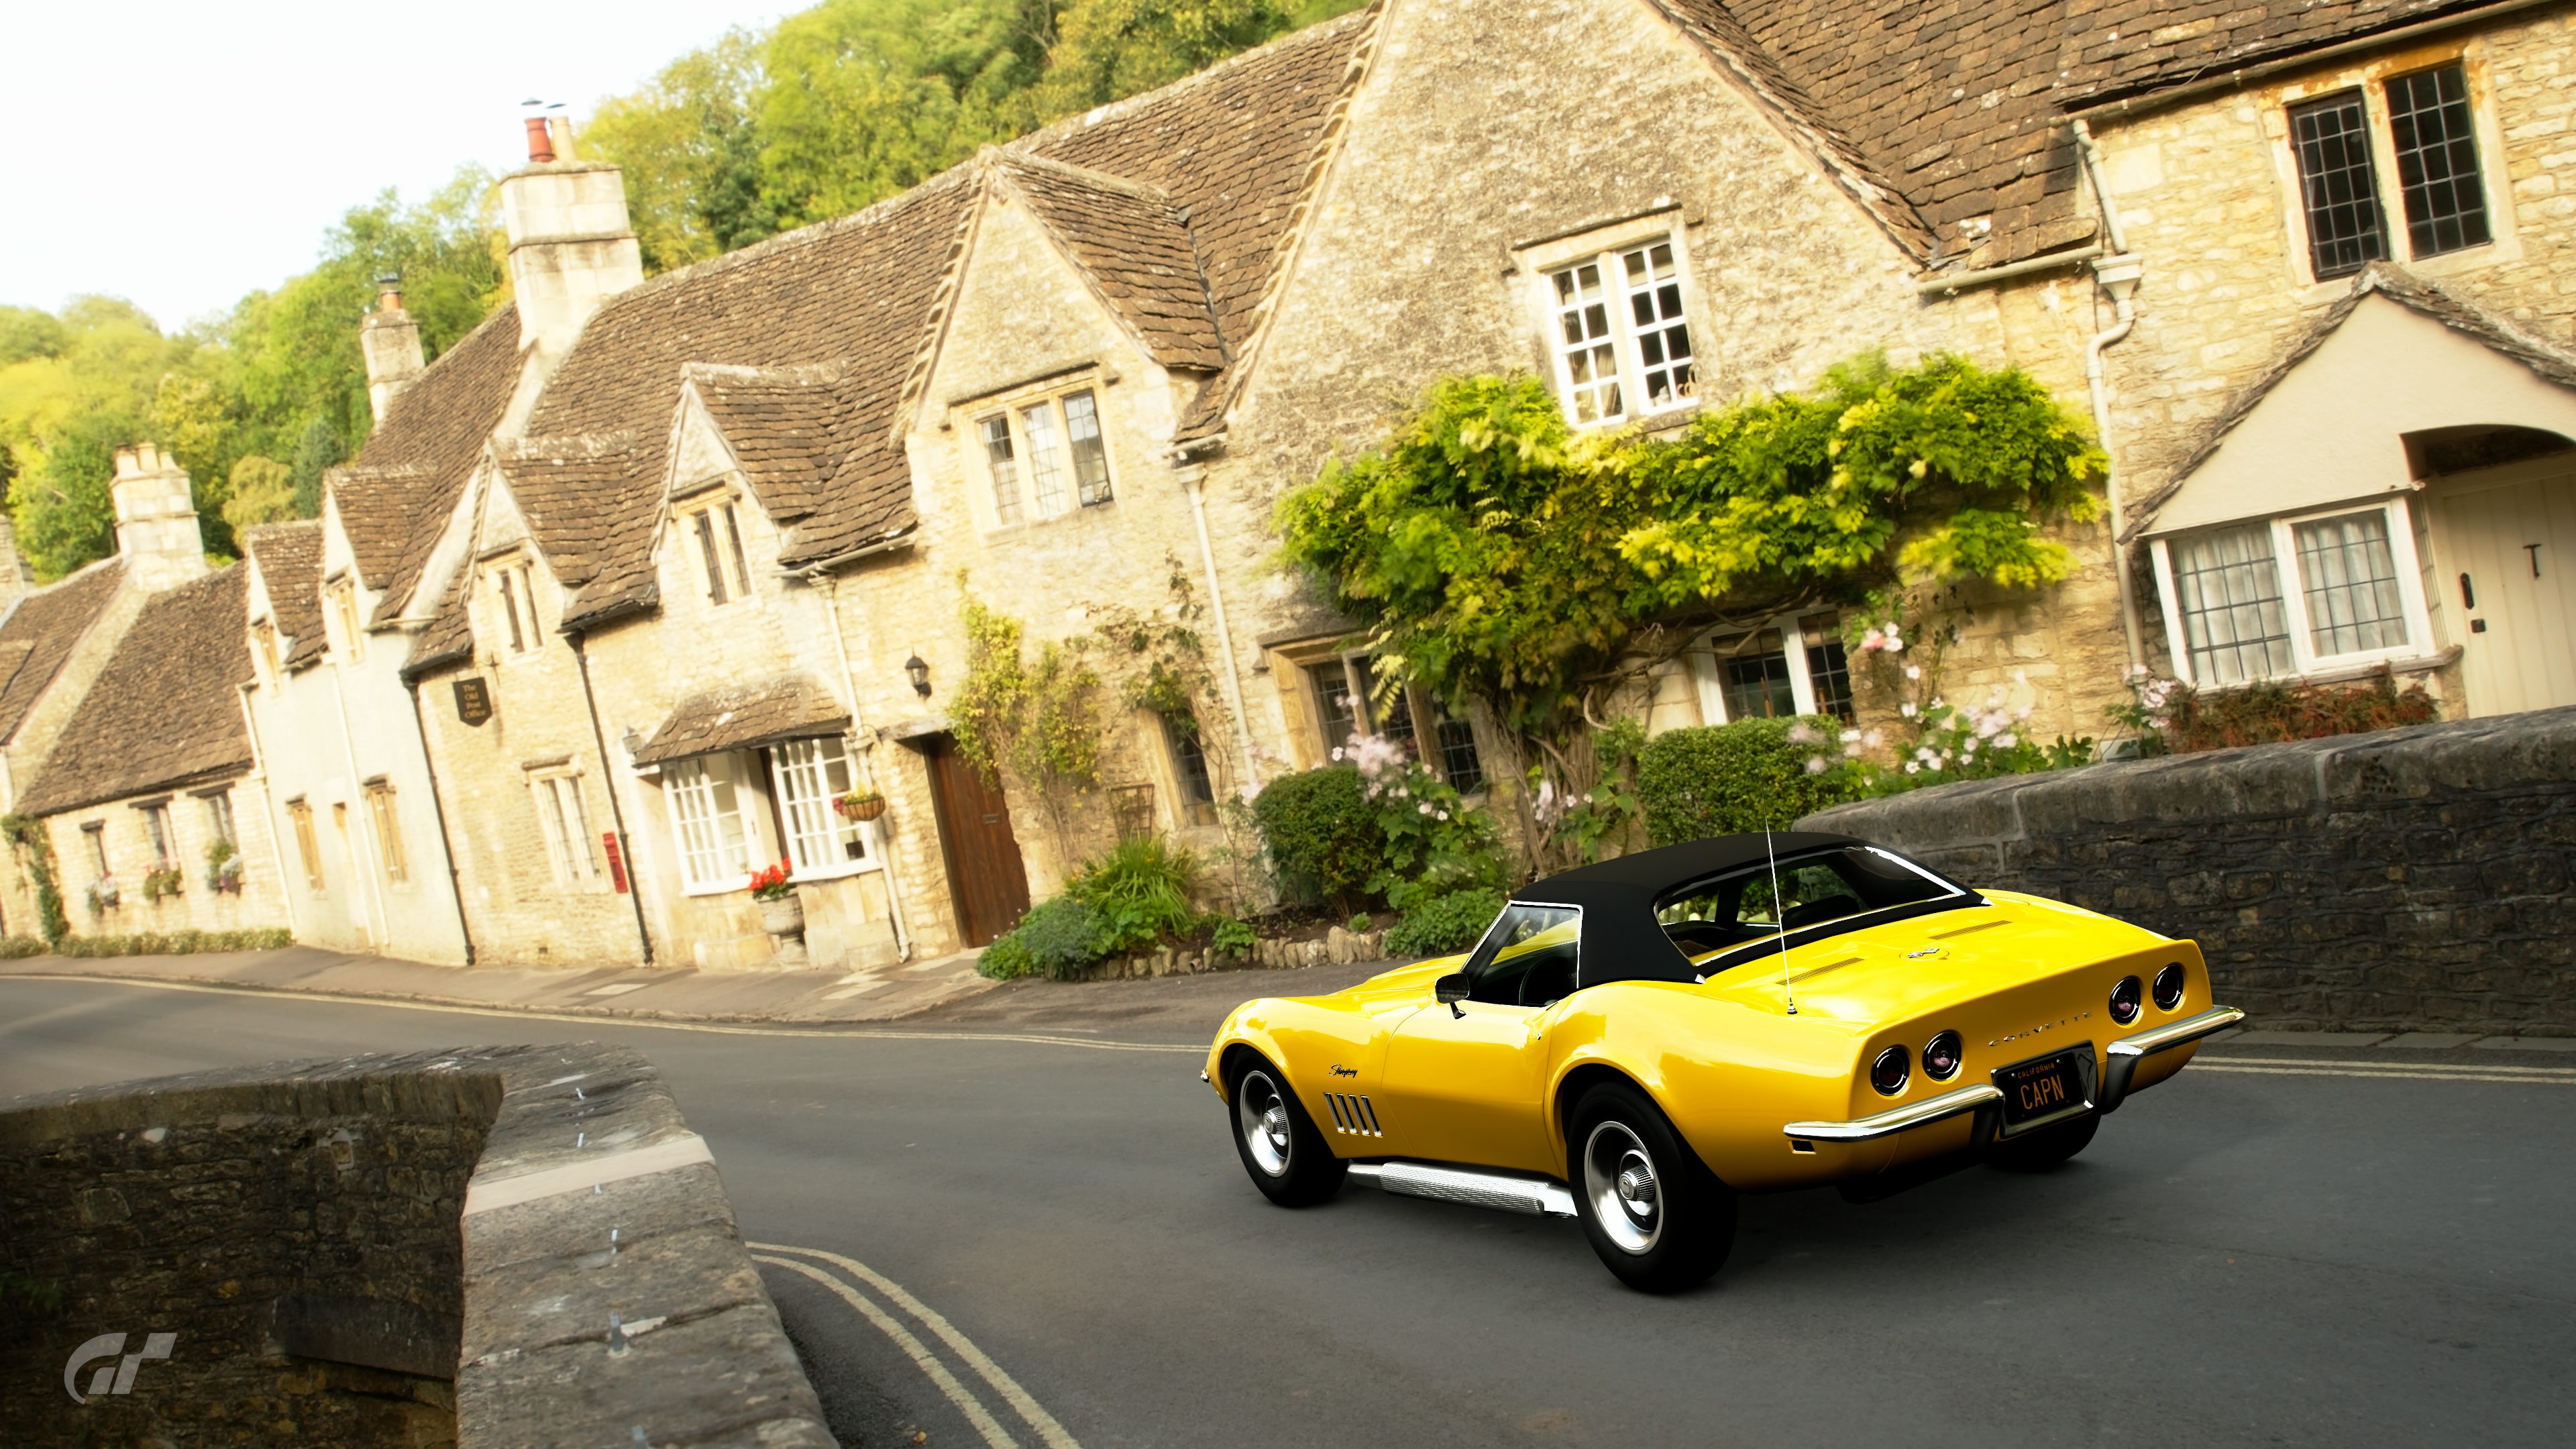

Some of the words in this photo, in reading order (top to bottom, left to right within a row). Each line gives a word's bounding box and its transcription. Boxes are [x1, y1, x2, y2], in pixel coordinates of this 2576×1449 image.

[1988, 1012, 2093, 1046] CORVETTE
[2017, 1062, 2055, 1079] CALIFORNIA
[2020, 1074, 2064, 1110] CAPN
